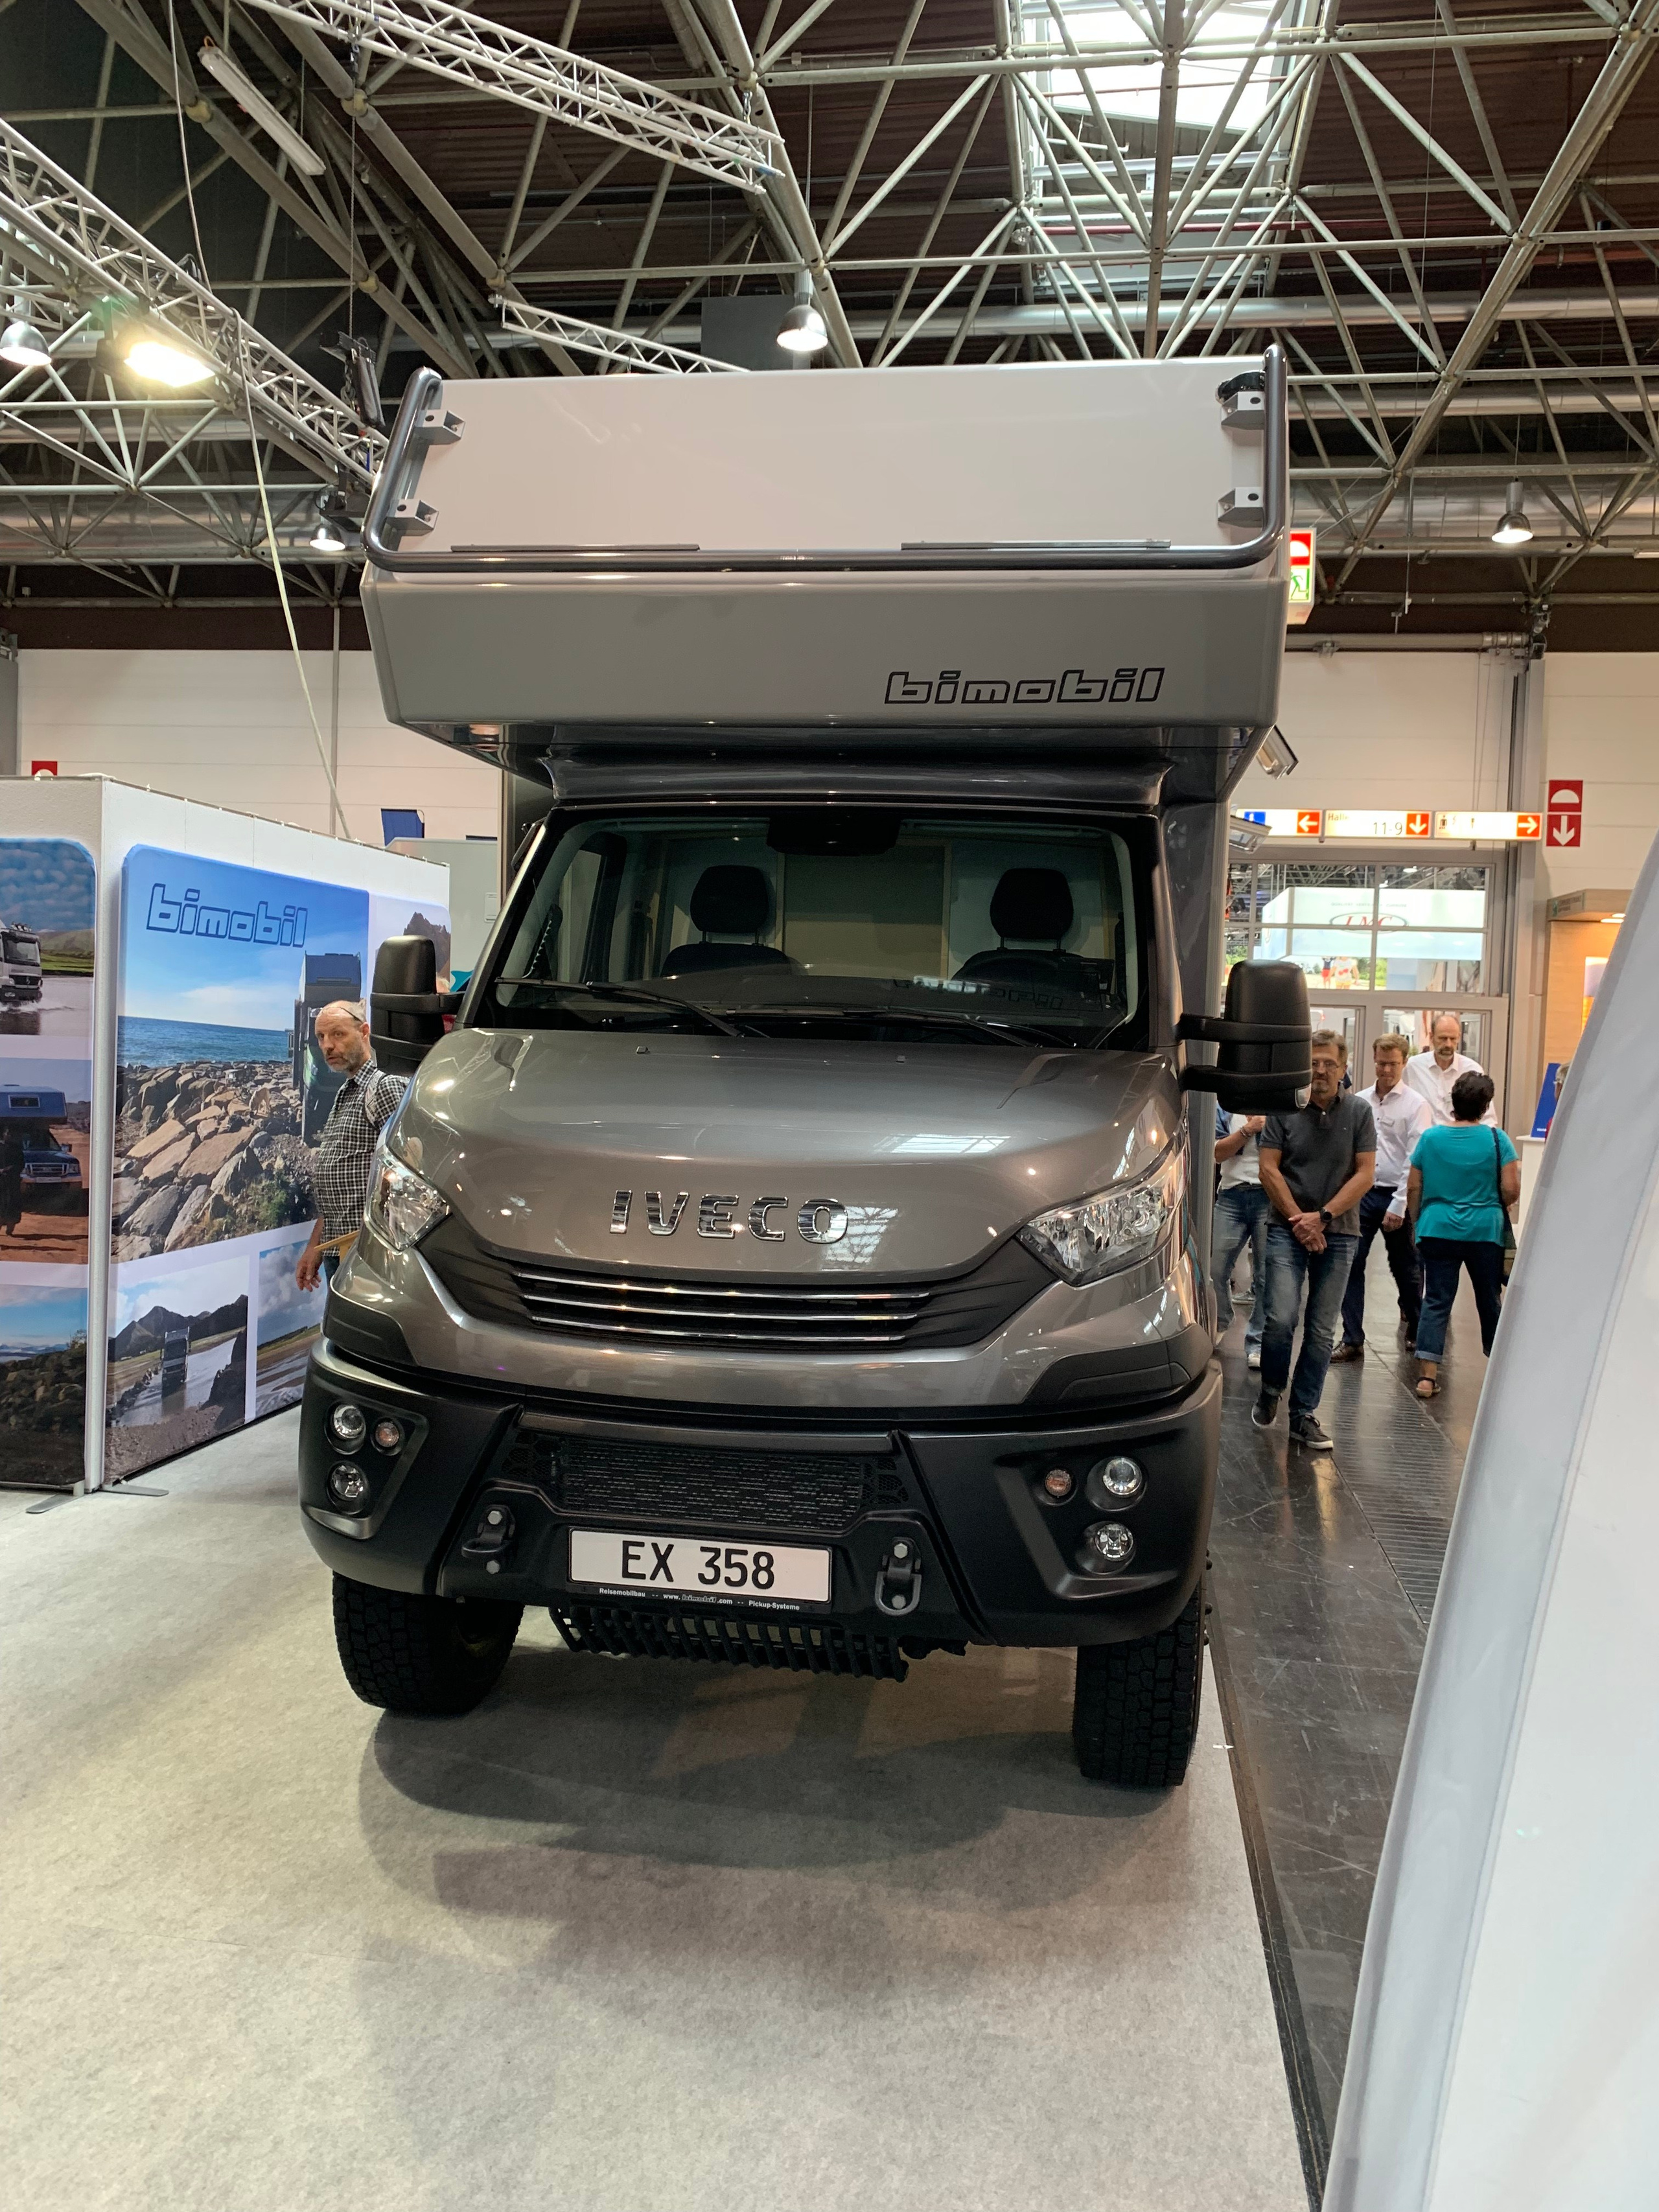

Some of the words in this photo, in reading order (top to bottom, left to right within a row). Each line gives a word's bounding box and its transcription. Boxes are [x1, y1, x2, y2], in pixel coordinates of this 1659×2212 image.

[885, 668, 1165, 704] bimobil
[1373, 822, 1403, 835] 11-9
[146, 883, 308, 948] bimobil
[610, 1190, 848, 1244] IVECO
[621, 1540, 675, 1583] EX
[697, 1546, 775, 1590] 358
[599, 1587, 646, 1598] Reisemobilbau
[748, 1600, 800, 1611] Pickup-Systeme
